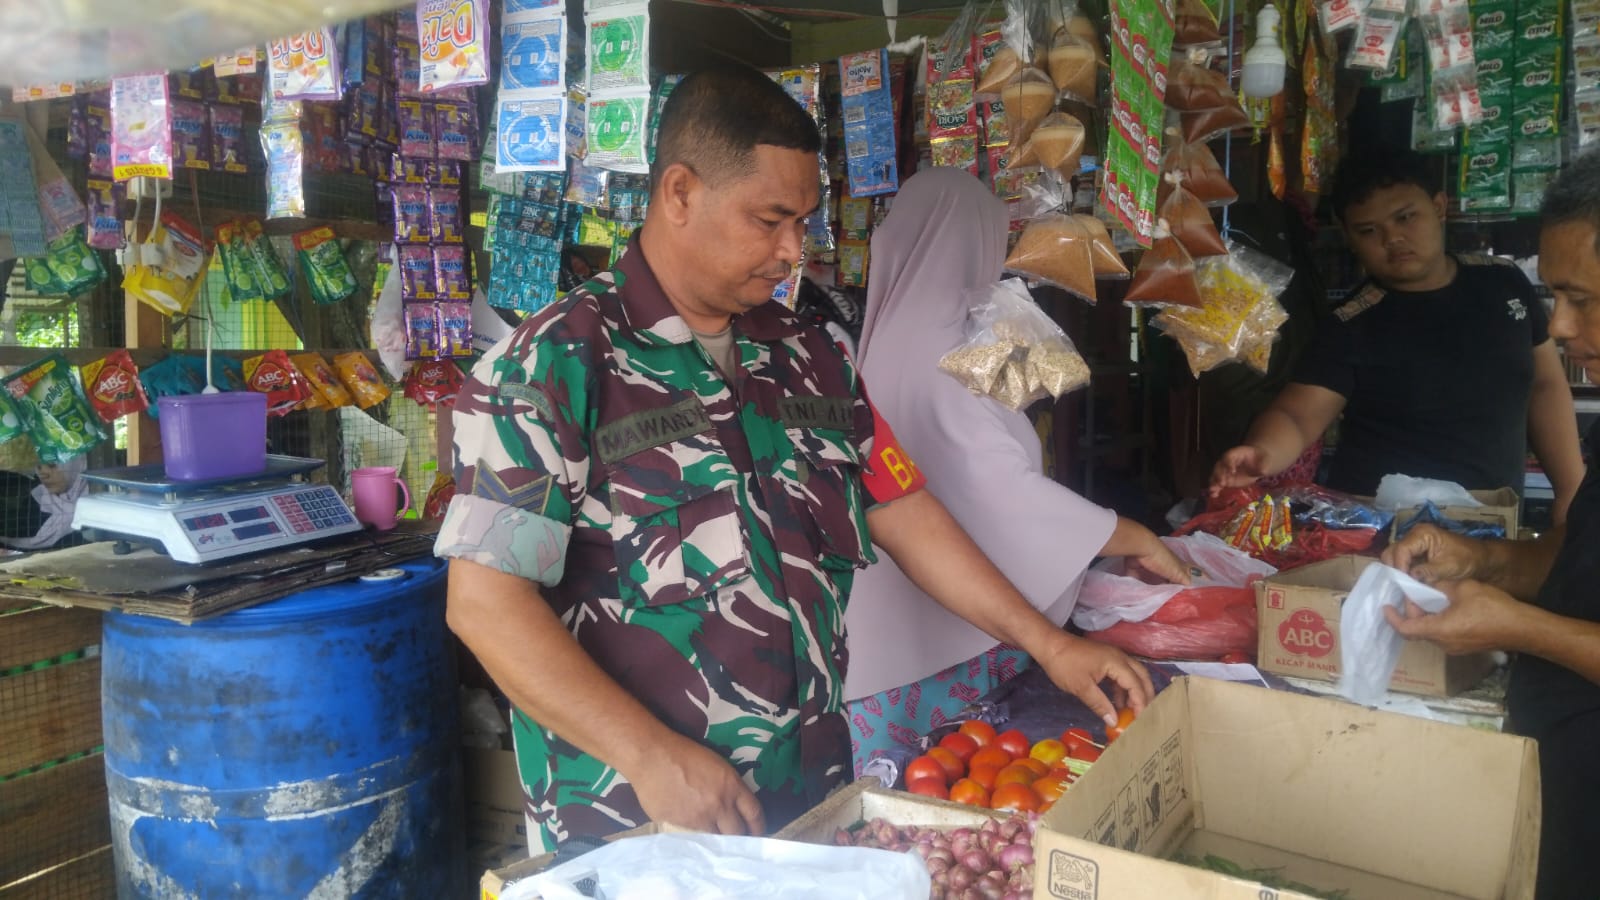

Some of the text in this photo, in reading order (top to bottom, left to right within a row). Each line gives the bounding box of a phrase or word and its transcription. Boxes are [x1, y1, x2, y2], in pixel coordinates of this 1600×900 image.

[1480, 15, 1502, 25] MILO
[1528, 25, 1552, 35] MILO
[1477, 62, 1500, 72] MILO
[1526, 73, 1550, 82] MILO
[938, 114, 966, 125] SAORI
[406, 130, 429, 141] Klin
[443, 132, 467, 143] Klin
[257, 370, 283, 385] ABC
[422, 366, 444, 380] ABC
[100, 373, 128, 392] ABC
[1283, 627, 1331, 648] ABC
[1275, 657, 1337, 673] KECAP MANIS
